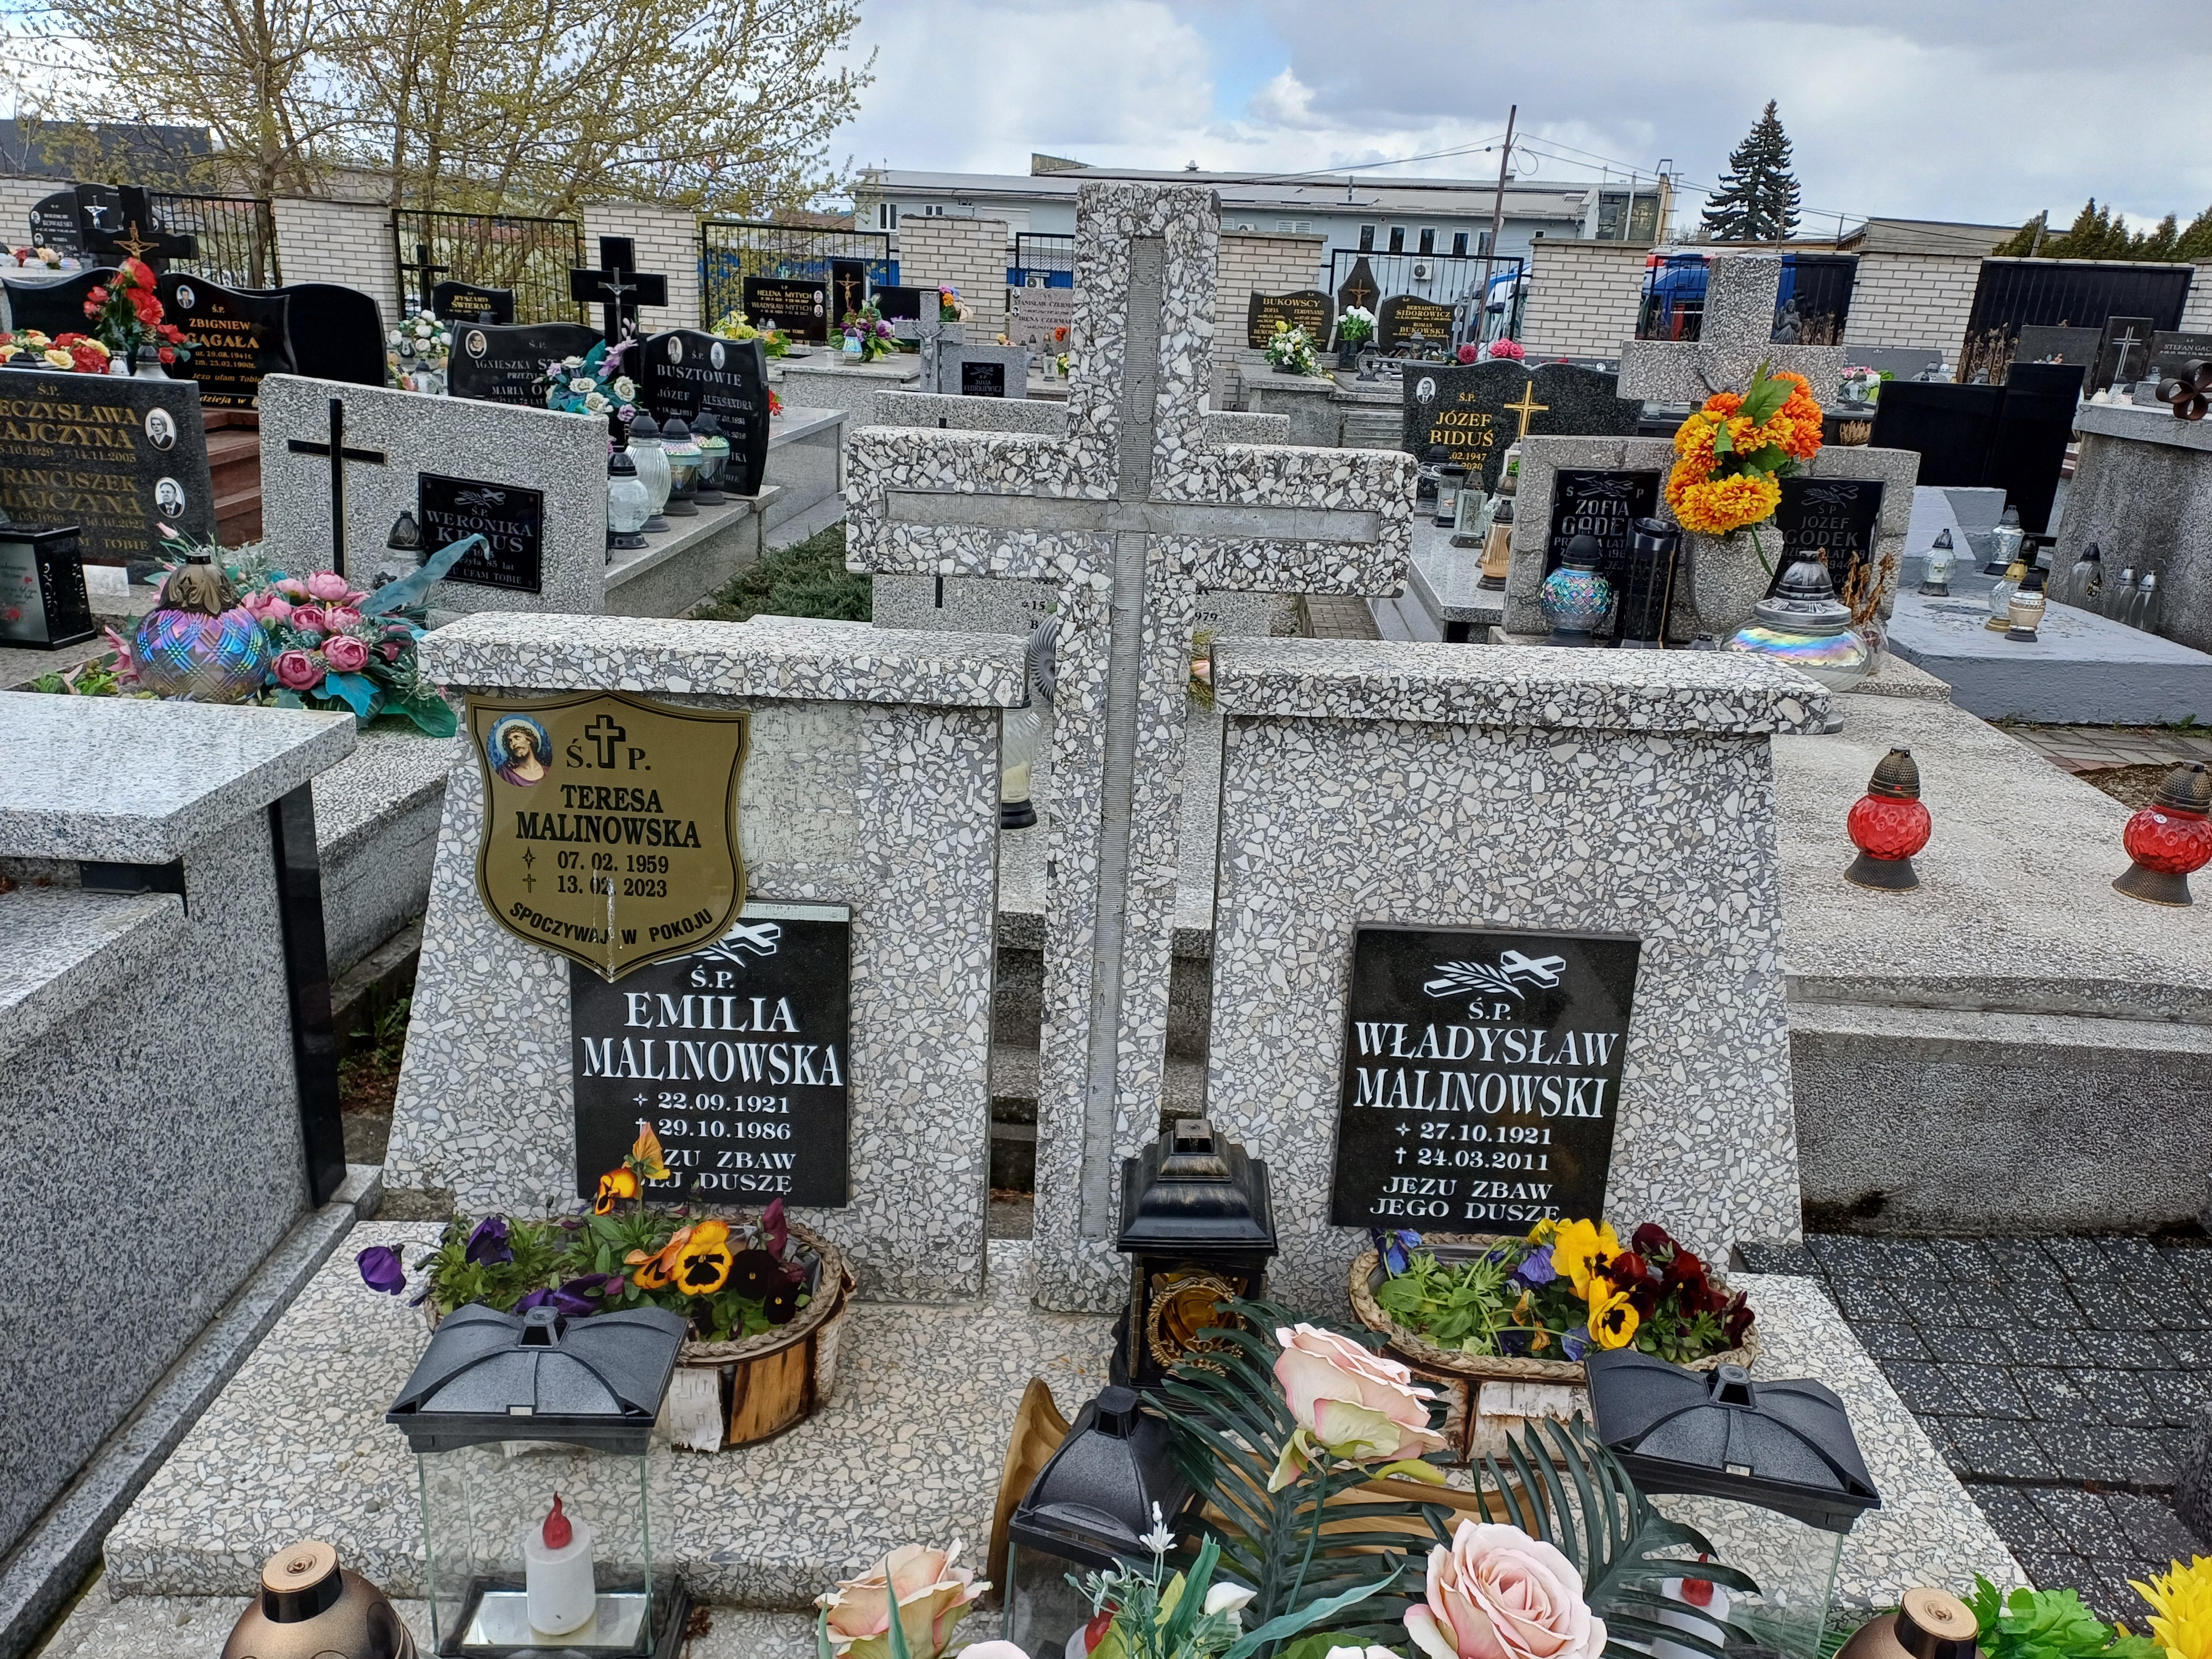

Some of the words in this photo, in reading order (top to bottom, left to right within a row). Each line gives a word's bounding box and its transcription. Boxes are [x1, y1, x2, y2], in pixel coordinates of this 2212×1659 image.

[1263, 298, 1321, 307] BUKOWSCY
[1396, 310, 1451, 318] SIDOROWICZ
[189, 318, 251, 331] ZBIGNIEW
[1400, 326, 1444, 335] BUKOWSKI
[474, 360, 530, 369] AGNIESZKA
[657, 364, 742, 387] BUSZTOWIE
[37, 382, 60, 397] Ś.P.
[492, 386, 524, 395] MARIA
[657, 387, 690, 401] JÓZEF
[1459, 392, 1476, 402] Ś.P.
[200, 394, 231, 404] dzieją
[702, 394, 753, 410] ALEKSANDRA
[0, 399, 142, 426] ECZYSŁAWA
[1436, 409, 1493, 427] JÓZEF
[0, 421, 136, 450] AJCZYNA
[1429, 429, 1493, 447] BIDUŚ
[1449, 451, 1487, 461] .02.1947
[0, 467, 139, 493] RANCISZEK
[1636, 488, 1644, 498] P
[472, 505, 488, 517] Ś.P.
[1575, 499, 1629, 515] ZOFIA
[1829, 505, 1837, 514] P
[425, 509, 533, 537] WERONIKA
[103, 538, 149, 550] TOBIE
[436, 526, 523, 552] KRUS
[1606, 539, 1626, 548] LAT
[1784, 529, 1859, 546] GODEK
[1827, 549, 1846, 559] LAT
[503, 562, 514, 570] lat
[463, 568, 489, 579] UFAM
[493, 572, 522, 584] TOBIE
[1032, 601, 1045, 610] 15
[1194, 612, 1217, 621] 979
[566, 738, 592, 769] Ś.
[626, 748, 651, 770] P.
[560, 784, 664, 813] TERESA
[515, 811, 701, 848] MALINOWSKA
[557, 851, 585, 870] 07.
[591, 852, 618, 872] 02.
[627, 854, 669, 874] 1959
[557, 875, 583, 894] 13.
[624, 878, 667, 898] 2023
[509, 902, 609, 945] SPOCZYWAJ
[622, 929, 637, 945] W
[649, 908, 713, 942] POKOJU
[691, 964, 734, 989] Ś.P.
[623, 992, 800, 1032] EMILIA
[1468, 997, 1511, 1021] Ś.P.
[1354, 1021, 1620, 1067] WŁADYSŁAW
[581, 1036, 844, 1086] MALINOWSKA
[1353, 1067, 1608, 1118] MALINOWSKI
[658, 1092, 790, 1114] 22.09.1921
[658, 1119, 791, 1140] 29.10.1986
[1420, 1122, 1552, 1145] 27.10.1921
[664, 1149, 701, 1166] ZU
[717, 1151, 796, 1170] ZBAW
[1418, 1147, 1549, 1171] 24.03.2011
[642, 1172, 682, 1188] EJ
[698, 1172, 792, 1196] DUSZĘ
[1383, 1176, 1458, 1196] JEZU
[1471, 1181, 1553, 1201] ZBAW
[1370, 1198, 1449, 1217] JEGO
